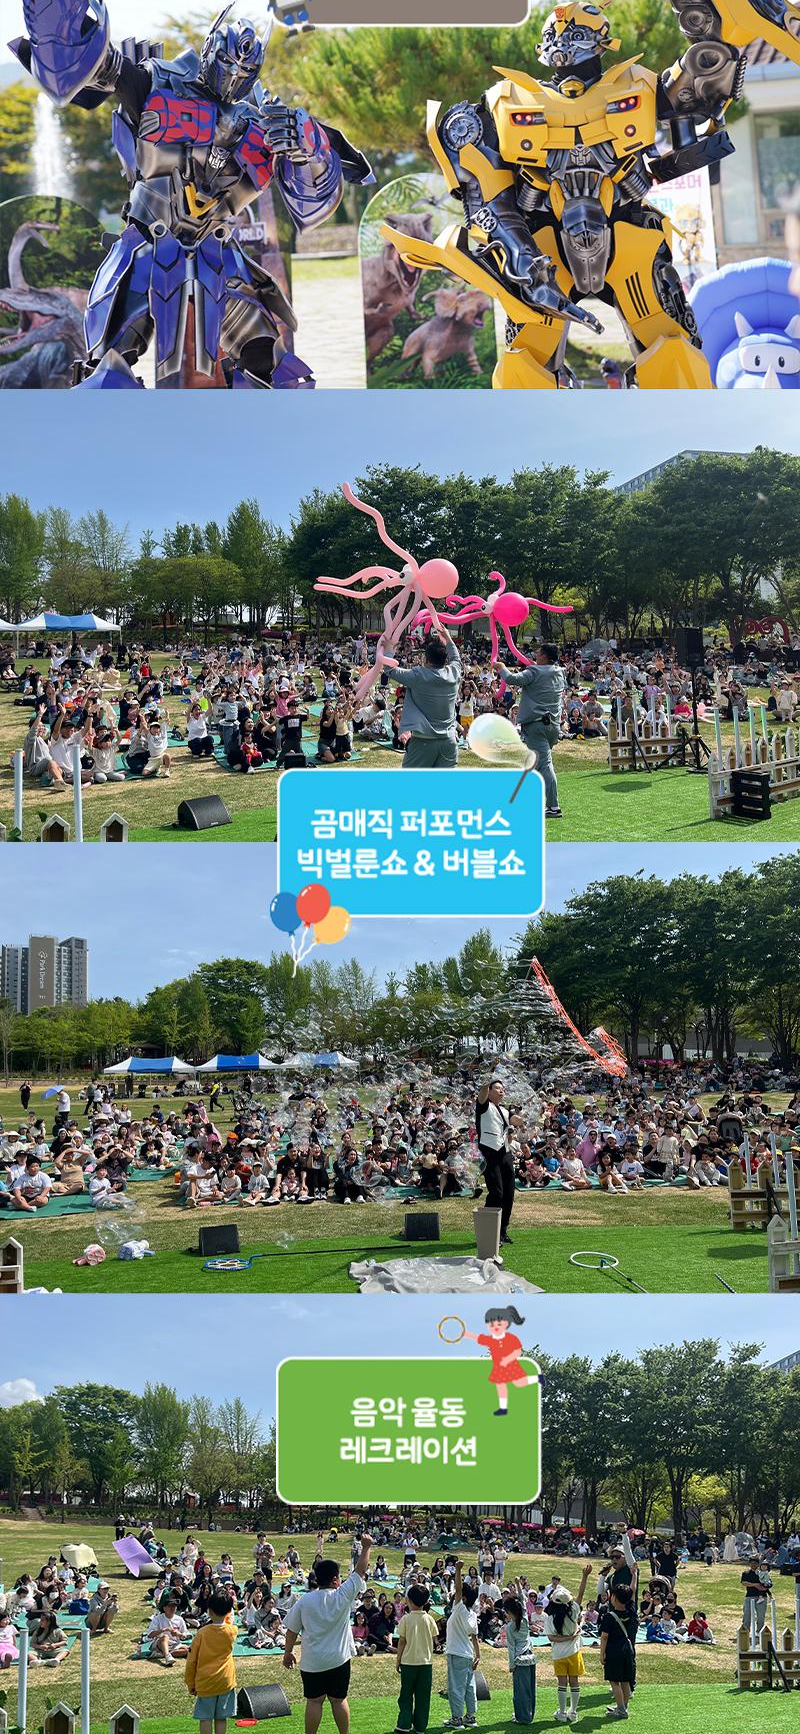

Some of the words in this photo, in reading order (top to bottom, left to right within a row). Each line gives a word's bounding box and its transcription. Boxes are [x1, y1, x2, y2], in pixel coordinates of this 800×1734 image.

[310, 808, 393, 840] 곰매직
[400, 808, 512, 840] 퍼포먼스
[297, 848, 409, 879] 빅벌룬쇼
[413, 849, 435, 876] &
[443, 848, 526, 879] 버블쇼
[350, 1394, 407, 1428] 음악
[411, 1397, 467, 1428] 율동
[339, 1435, 477, 1467] 레크레이션
